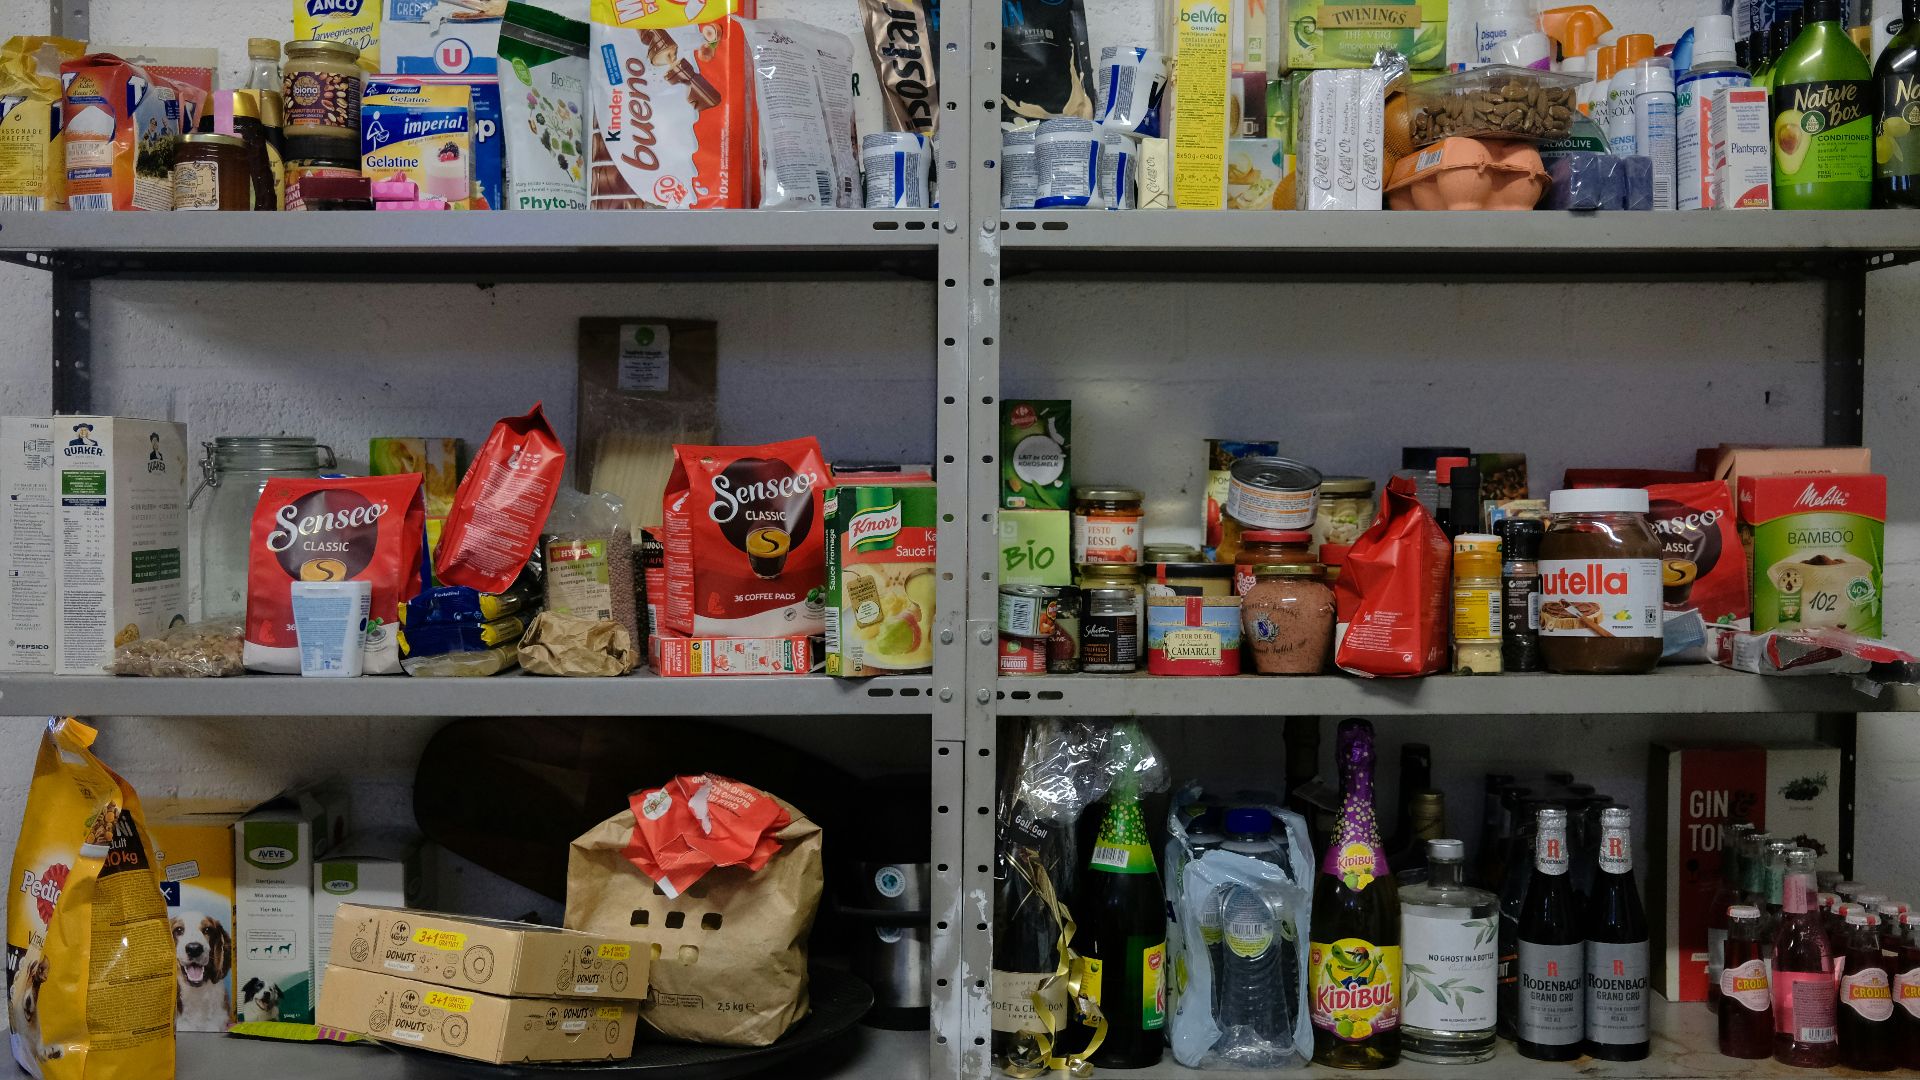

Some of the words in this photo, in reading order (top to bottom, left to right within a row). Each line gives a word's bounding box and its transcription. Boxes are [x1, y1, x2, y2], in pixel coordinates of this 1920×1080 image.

[312, 0, 357, 11] ANCO
[1180, 6, 1227, 24] belVita
[1331, 7, 1408, 26] TWININGS
[311, 21, 374, 41] Tarwegriesmeel
[442, 48, 463, 67] U
[294, 86, 318, 94] biona
[386, 86, 419, 95] imperial
[390, 95, 431, 103] Gelatine
[1793, 83, 1858, 112] Nature
[621, 57, 660, 172] bueno
[1828, 102, 1862, 126] Box
[403, 115, 463, 136] imperial
[1731, 142, 1768, 155] Plantspray
[366, 155, 419, 168] Gelatine
[64, 446, 103, 457] QUAKER
[148, 460, 166, 472] QUAKER
[708, 471, 818, 524] Senseo
[1793, 482, 1849, 508] Melitta
[746, 510, 787, 521] CLASSIC
[266, 500, 389, 552] Senseo
[851, 515, 899, 539] Knorr
[1088, 536, 1116, 546] ROSSO
[1788, 530, 1854, 545] BAMBOO
[303, 541, 350, 552] CLASSIC
[829, 528, 837, 566] Fromage
[896, 546, 926, 557] Sauce
[744, 593, 774, 601] COFFEE
[1850, 586, 1869, 595] 40%
[1809, 590, 1838, 612] 102
[797, 640, 805, 670] Royco
[1171, 648, 1217, 656] CAMARGUE
[1689, 790, 1729, 818] GIN
[1015, 815, 1031, 829] Gall
[1032, 824, 1048, 838] Gall
[1547, 839, 1560, 858] R
[1608, 836, 1622, 858] R
[418, 930, 440, 944] 3+1
[386, 950, 417, 962] DONUTS
[1478, 952, 1494, 962] BOTTLE
[1547, 960, 1559, 977] R
[1613, 960, 1624, 977] R
[576, 974, 600, 984] DONUTS
[1523, 973, 1581, 992] RODENBACH
[1588, 972, 1648, 991] RODENBACH
[430, 994, 448, 1006] 3+1
[1530, 991, 1557, 1002] GRAND
[1560, 992, 1574, 1002] CRU
[1596, 990, 1624, 1001] GRAND
[1626, 991, 1640, 1001] CRU
[563, 1007, 589, 1019] DONUTS
[717, 1002, 730, 1012] 2,5
[732, 1001, 744, 1013] kg
[1022, 1002, 1064, 1012] CHDON
[395, 1018, 426, 1032] DONUTS
